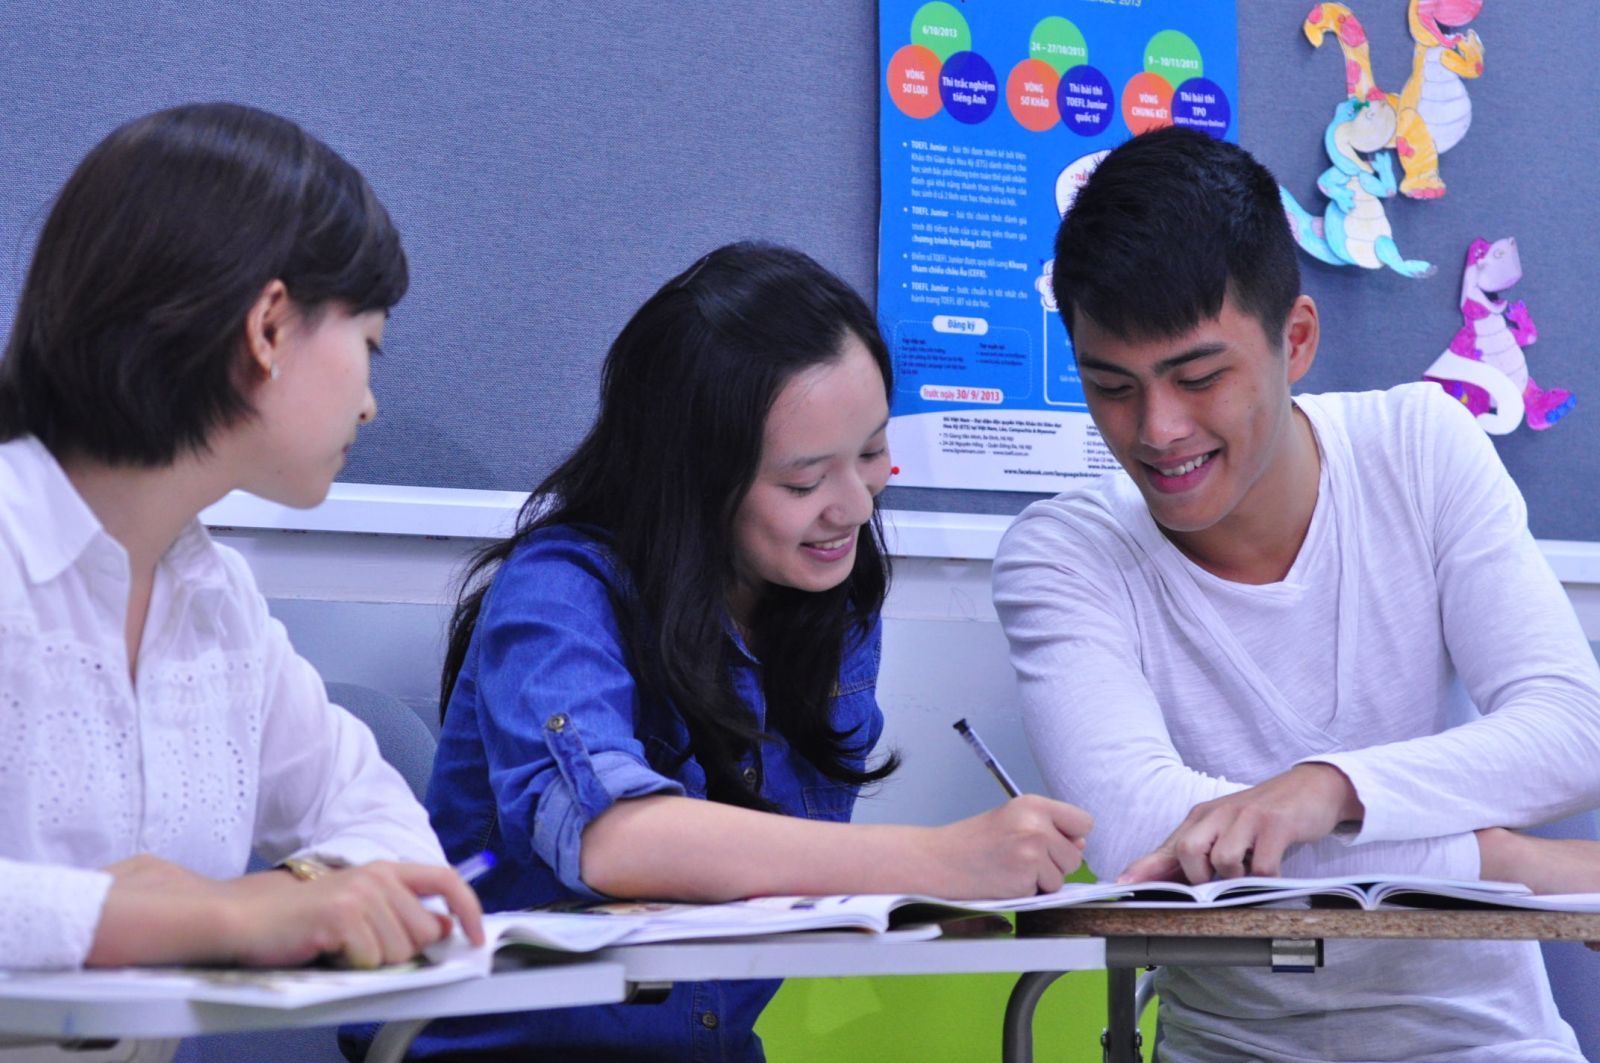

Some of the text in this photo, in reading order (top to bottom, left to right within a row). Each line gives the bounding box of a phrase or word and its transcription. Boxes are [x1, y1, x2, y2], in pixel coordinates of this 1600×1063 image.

[922, 24, 958, 38] 6/10/2013
[942, 76, 953, 87] Thi
[1069, 82, 1103, 96] Thi bài thi
[1066, 96, 1108, 110] TOEFL Junior
[1180, 92, 1215, 104] Thi bài thi
[1192, 106, 1206, 117] TPO
[947, 319, 976, 332] Đăng ký
